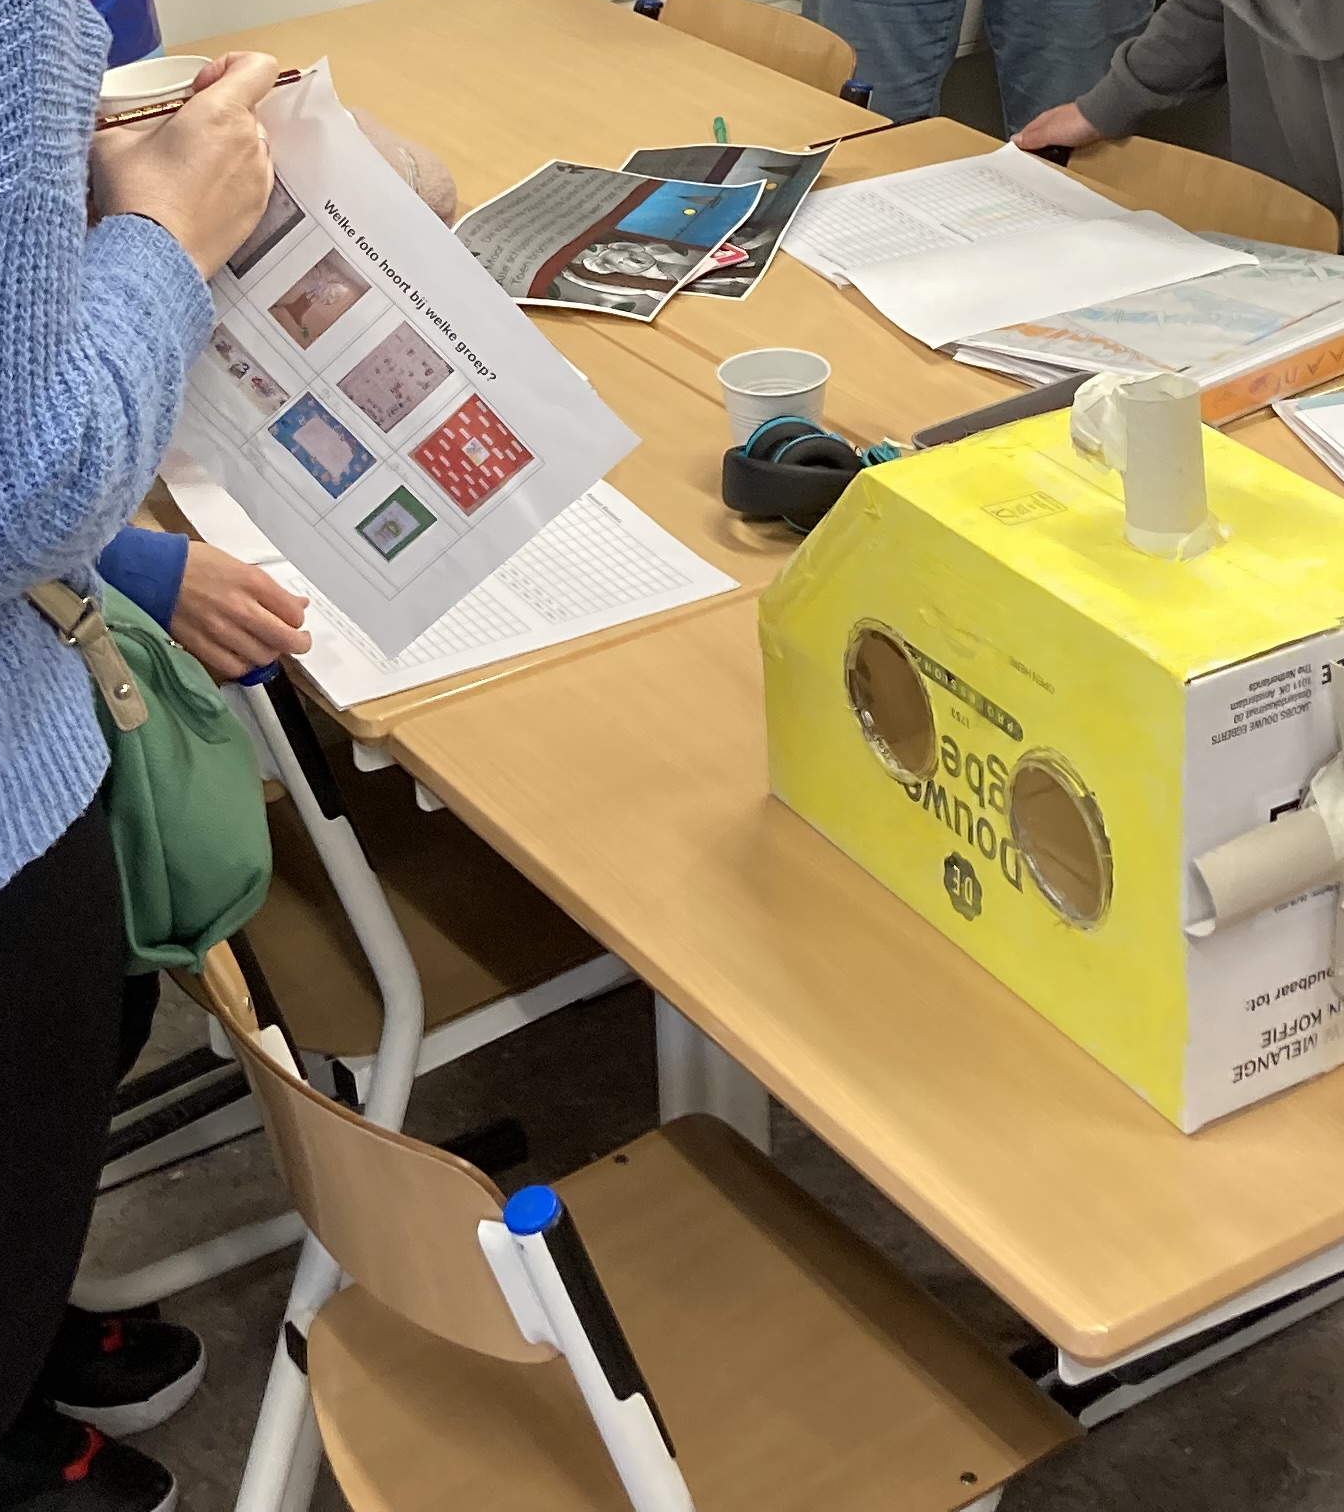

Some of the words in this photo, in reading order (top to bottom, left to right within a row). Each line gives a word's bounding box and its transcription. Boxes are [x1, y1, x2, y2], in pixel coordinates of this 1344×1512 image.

[324, 199, 356, 238] Welke
[355, 235, 379, 262] foto
[379, 259, 412, 294] hoort
[409, 290, 428, 310] bij
[425, 307, 457, 341] welke
[455, 341, 497, 382] groep?
[1009, 655, 1032, 680] HERE
[1297, 663, 1312, 674] The
[1030, 671, 1056, 695] OPEN
[1249, 668, 1296, 692] Netherlands
[1293, 678, 1312, 690] 1011
[1230, 689, 1275, 710] Amsterdam
[1281, 701, 1312, 720] JACOBS
[1249, 714, 1279, 732] DOUWE
[1211, 724, 1248, 746] EGBERTS
[1274, 967, 1335, 1007] oudbaar
[1245, 996, 1270, 1012] tot:
[1261, 1008, 1322, 1049] KOFFIE
[1232, 1032, 1318, 1084] MELANGE
